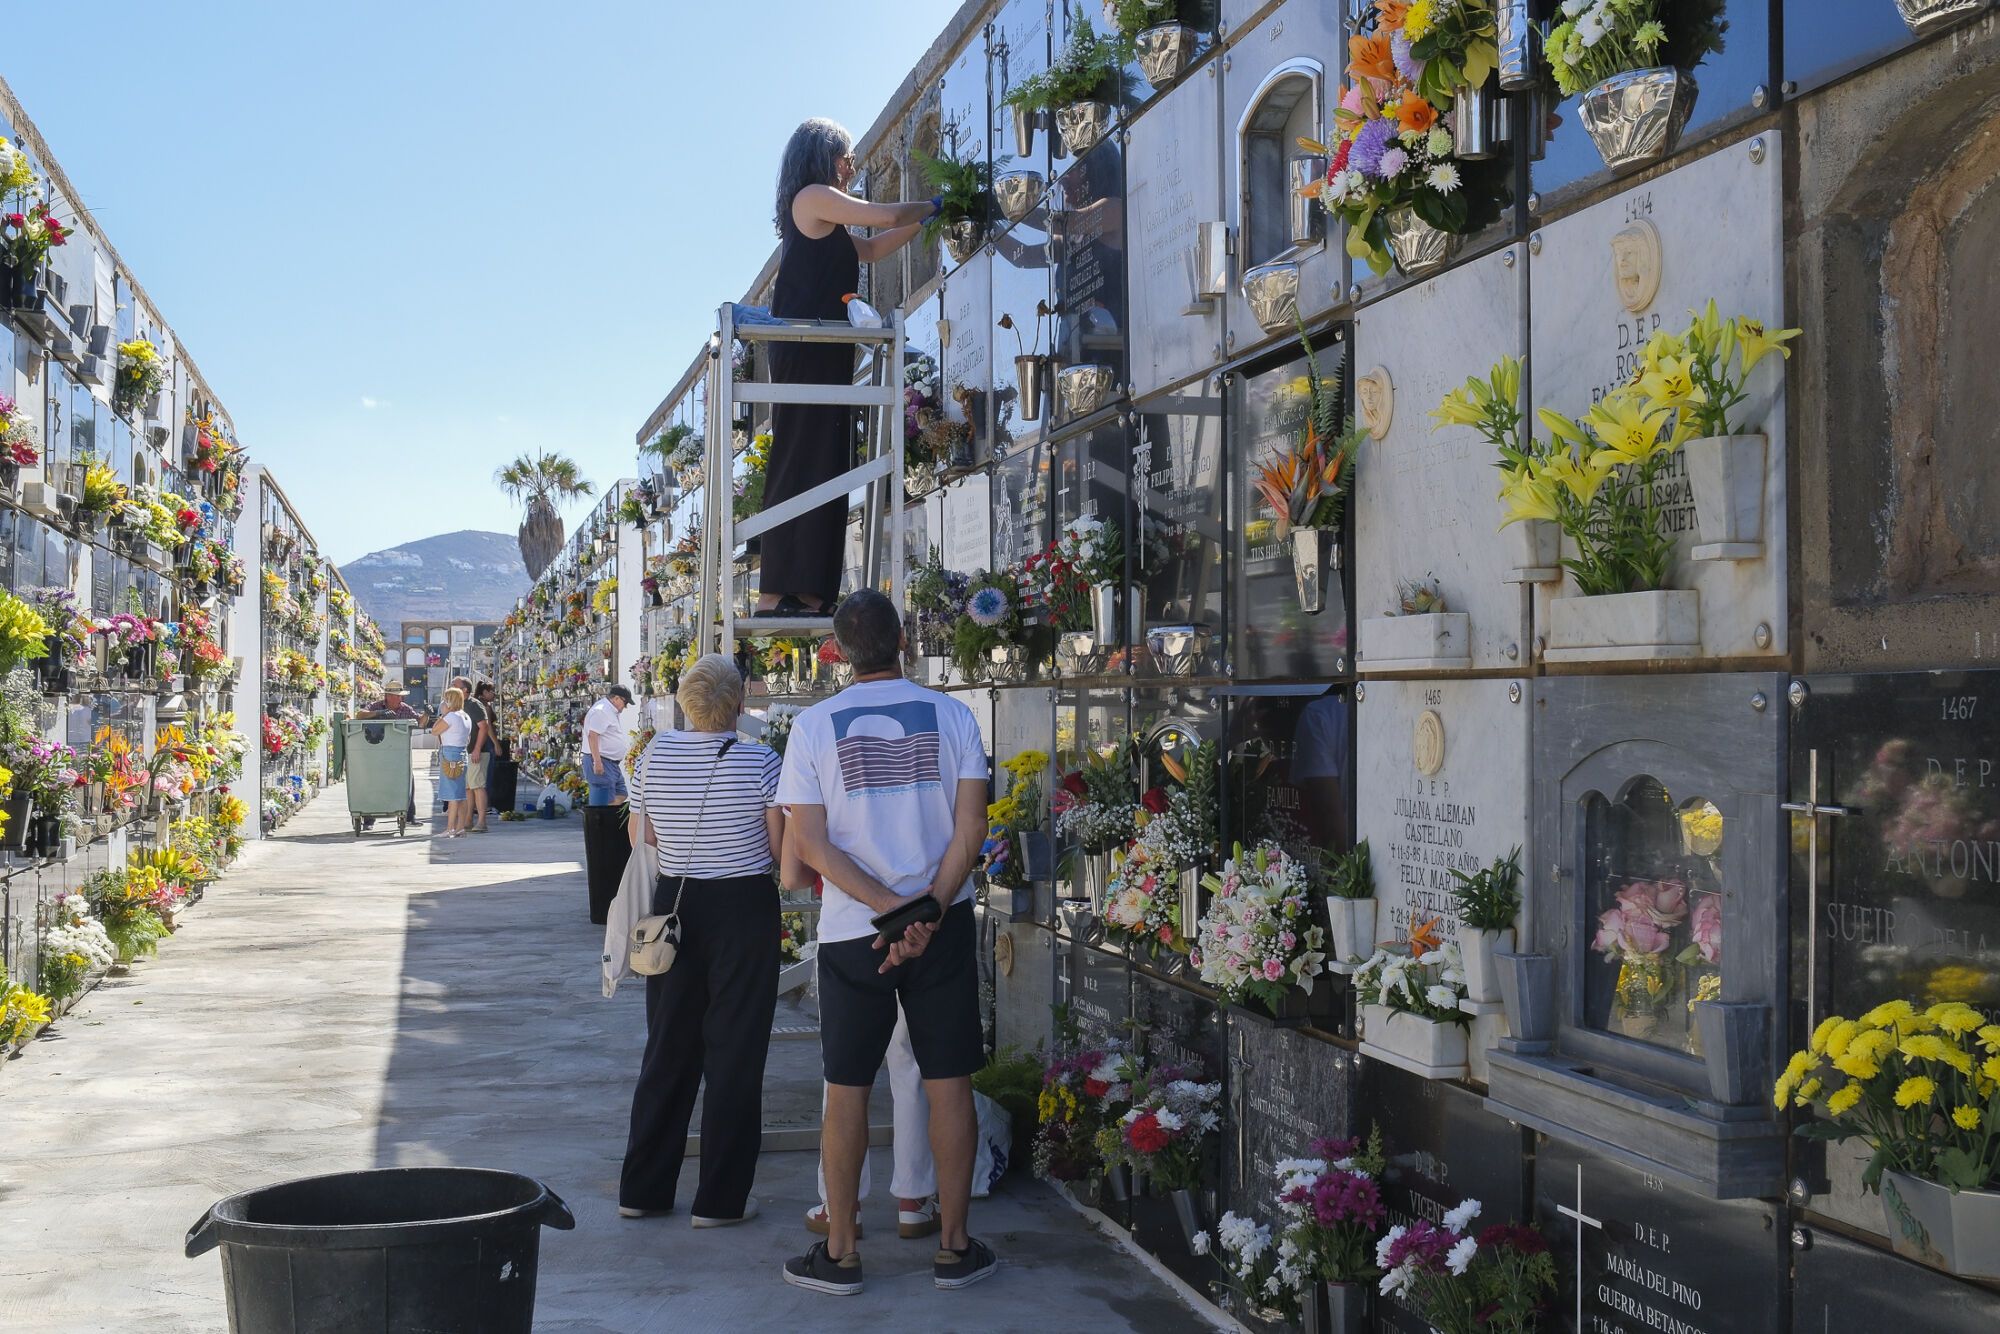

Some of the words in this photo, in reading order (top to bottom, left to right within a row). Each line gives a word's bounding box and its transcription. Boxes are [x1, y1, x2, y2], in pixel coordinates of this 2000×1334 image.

[1624, 191, 1653, 225] 1494
[1662, 505, 1699, 534] NIET
[1424, 689, 1442, 706] 1465
[1941, 696, 1977, 720] 1467
[1394, 798, 1432, 821] JULIANA
[1435, 803, 1476, 827] ALEMAN
[1405, 822, 1463, 849] CASTELLANO
[1430, 849, 1445, 867] LOS
[1457, 851, 1480, 873] AÑOS
[1400, 864, 1426, 887] FELIX
[1429, 868, 1468, 893] MARTI
[1249, 1090, 1279, 1120] SANTIAGO
[1607, 1251, 1645, 1286] MARÍA
[1646, 1268, 1670, 1297] DEL
[1672, 1280, 1701, 1311] PINO
[1598, 1284, 1645, 1322] GUERRA
[1646, 1305, 1709, 1334] BETAN
